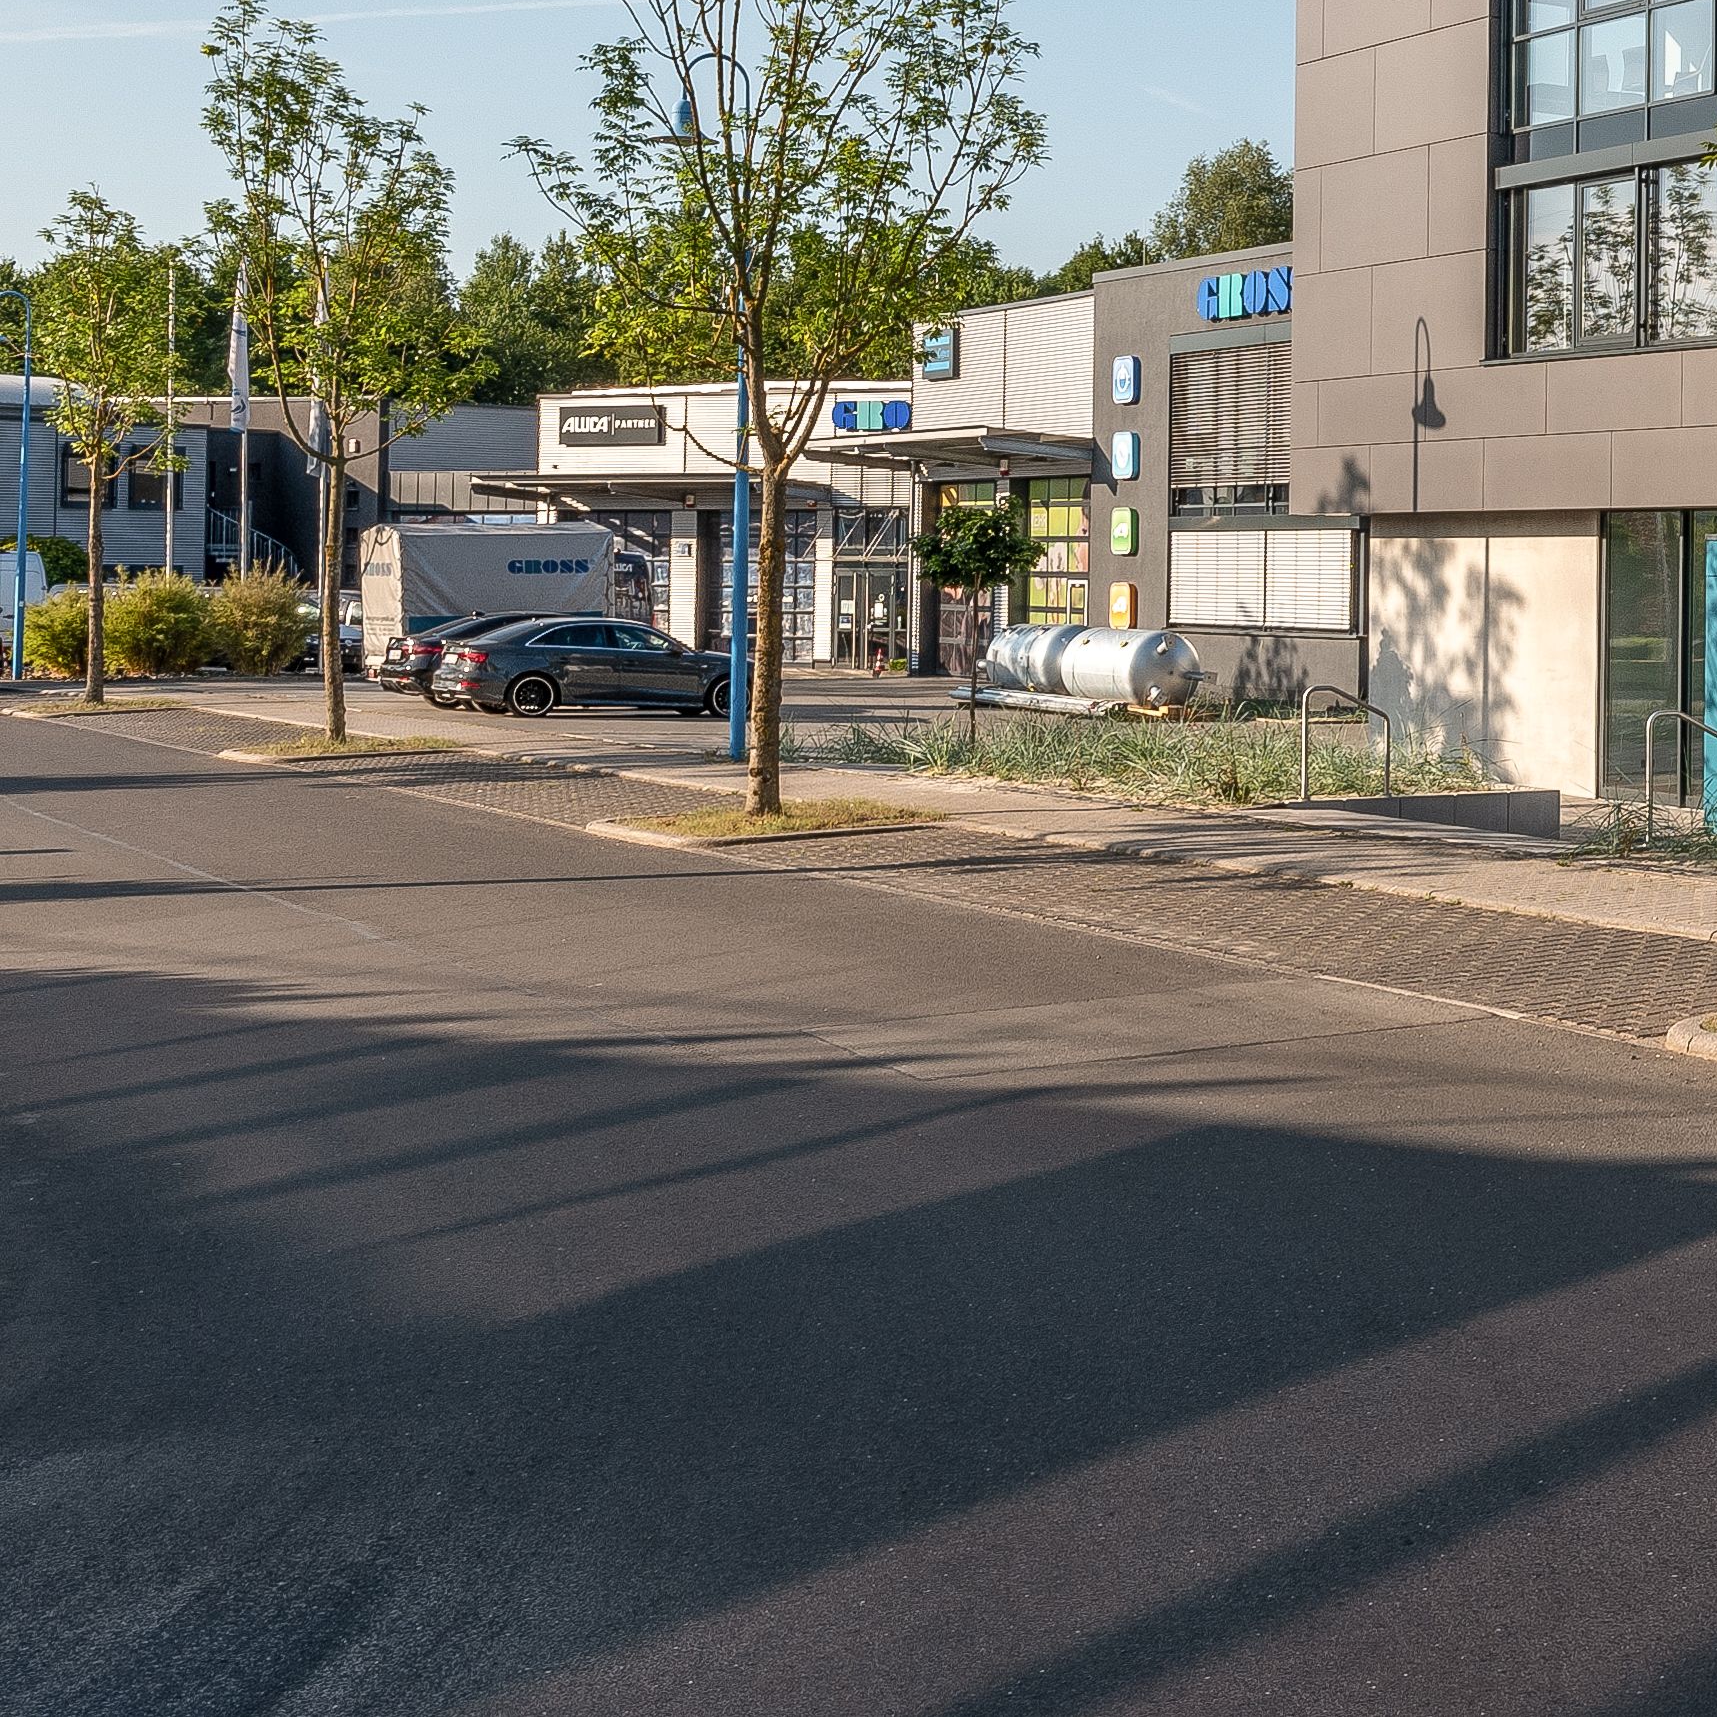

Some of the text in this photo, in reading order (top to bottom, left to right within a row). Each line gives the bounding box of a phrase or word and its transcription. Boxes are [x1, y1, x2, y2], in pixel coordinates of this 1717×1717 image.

[1197, 266, 1293, 321] GROS
[615, 418, 656, 429] PARTNER
[507, 559, 590, 574] GROSS
